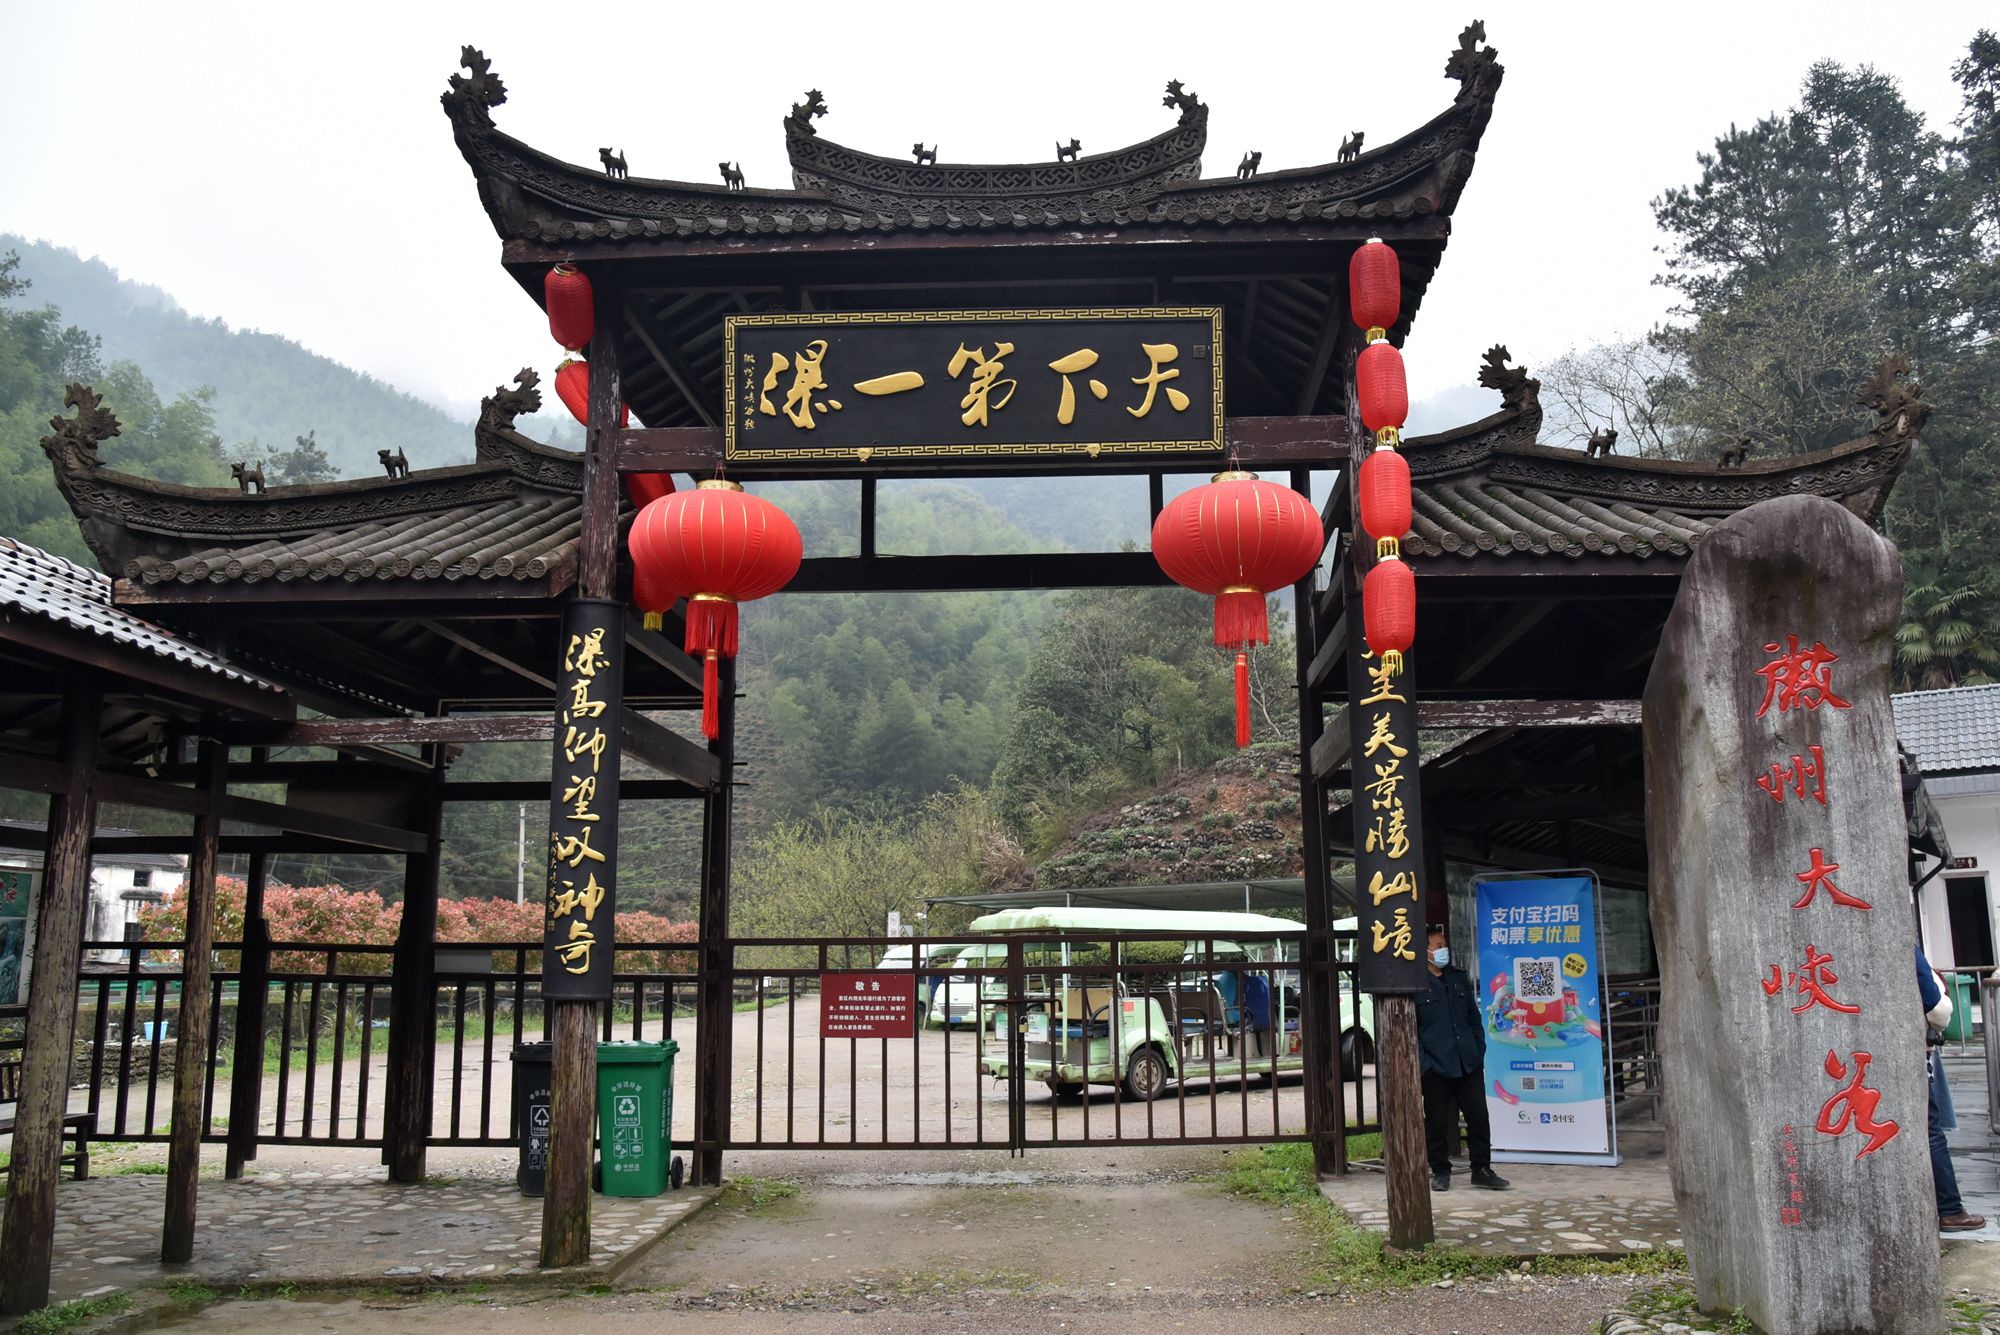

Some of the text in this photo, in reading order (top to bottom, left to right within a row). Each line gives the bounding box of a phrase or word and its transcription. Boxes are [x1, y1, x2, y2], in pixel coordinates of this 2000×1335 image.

[1491, 904, 1580, 925] 支付宝扫码
[1490, 925, 1581, 945] 购票享优惠
[1552, 1114, 1575, 1123] 支付宝
